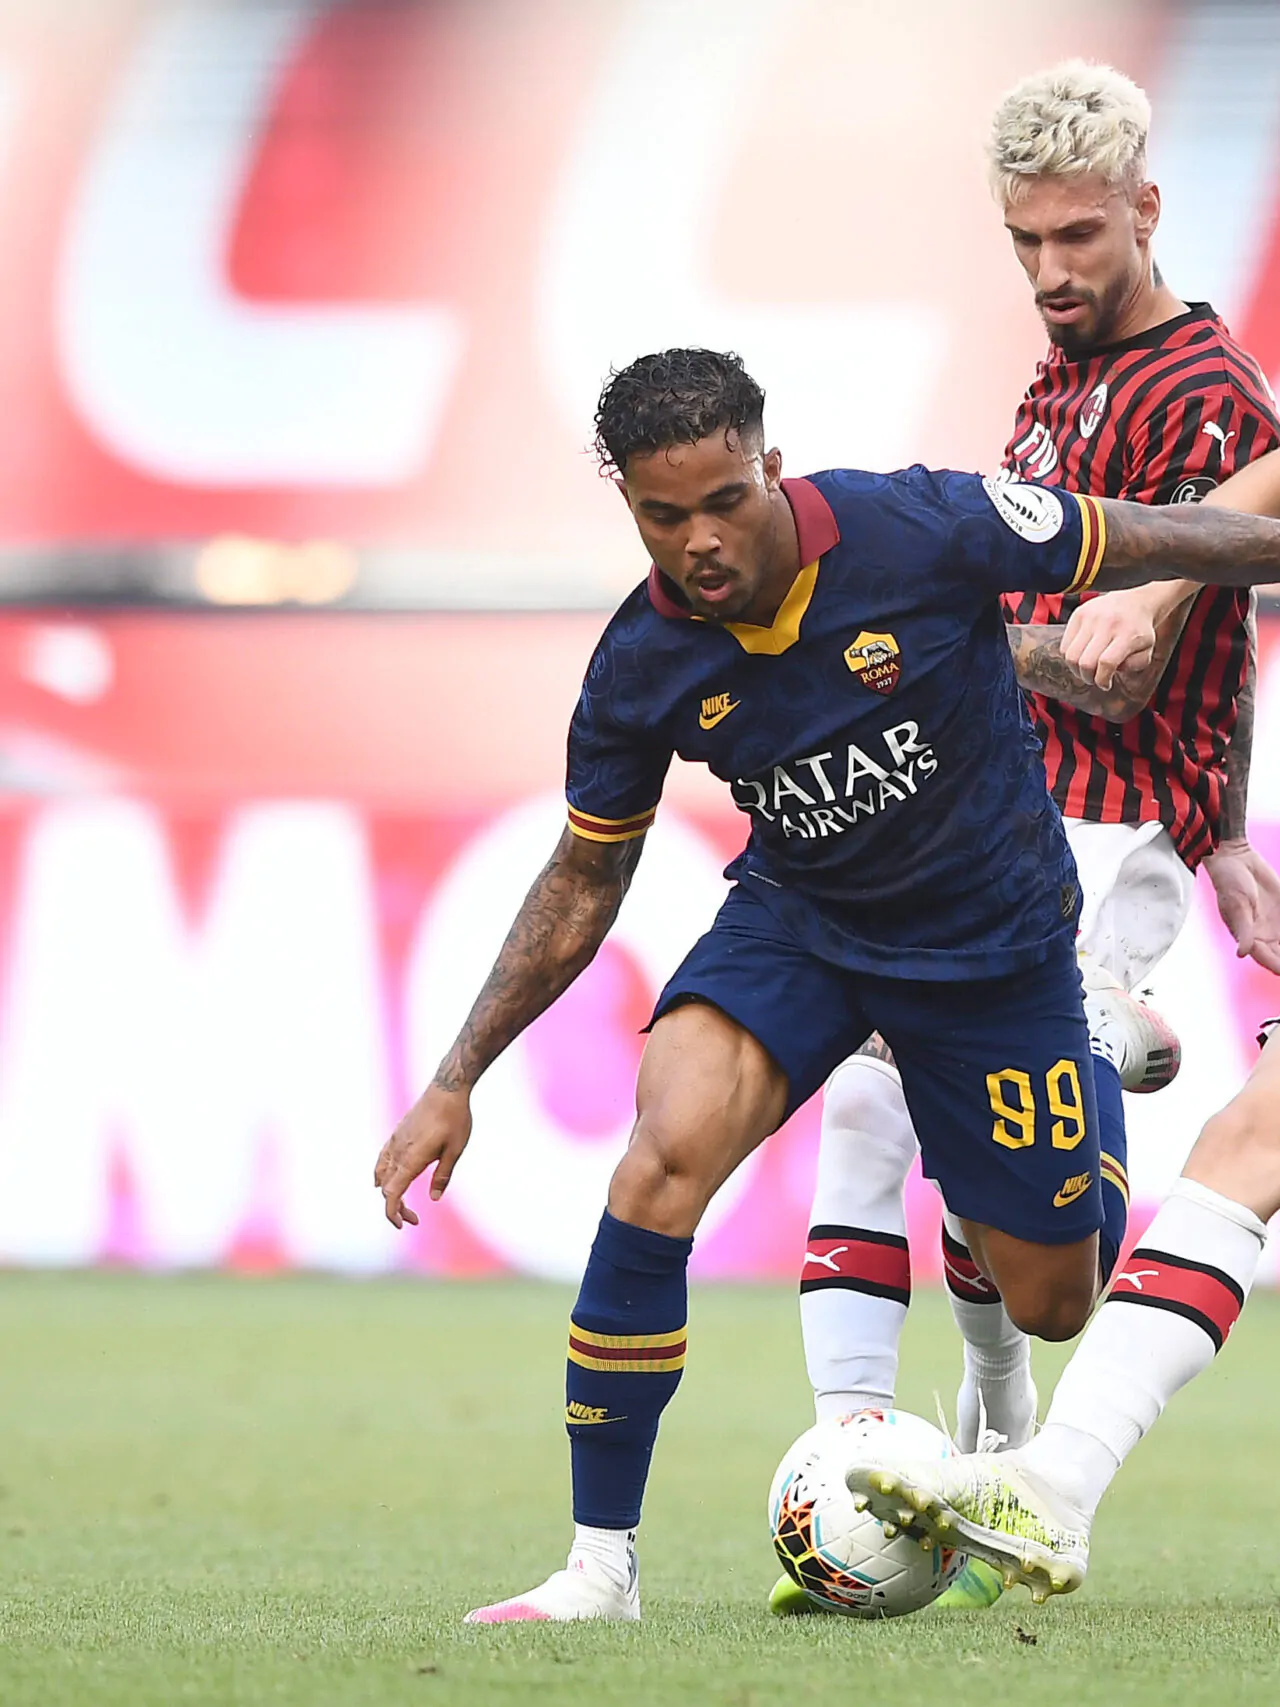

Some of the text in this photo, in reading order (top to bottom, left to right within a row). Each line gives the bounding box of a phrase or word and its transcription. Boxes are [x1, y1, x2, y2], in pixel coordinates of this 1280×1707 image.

[1013, 421, 1058, 479] Fly
[860, 662, 900, 684] ROMA
[701, 692, 730, 717] NIKE
[736, 720, 932, 822] QATAR
[782, 749, 938, 838] AIRWAYS
[986, 1059, 1086, 1150] 99
[1061, 1172, 1090, 1194] NIKE
[569, 1400, 608, 1421] NIKE
